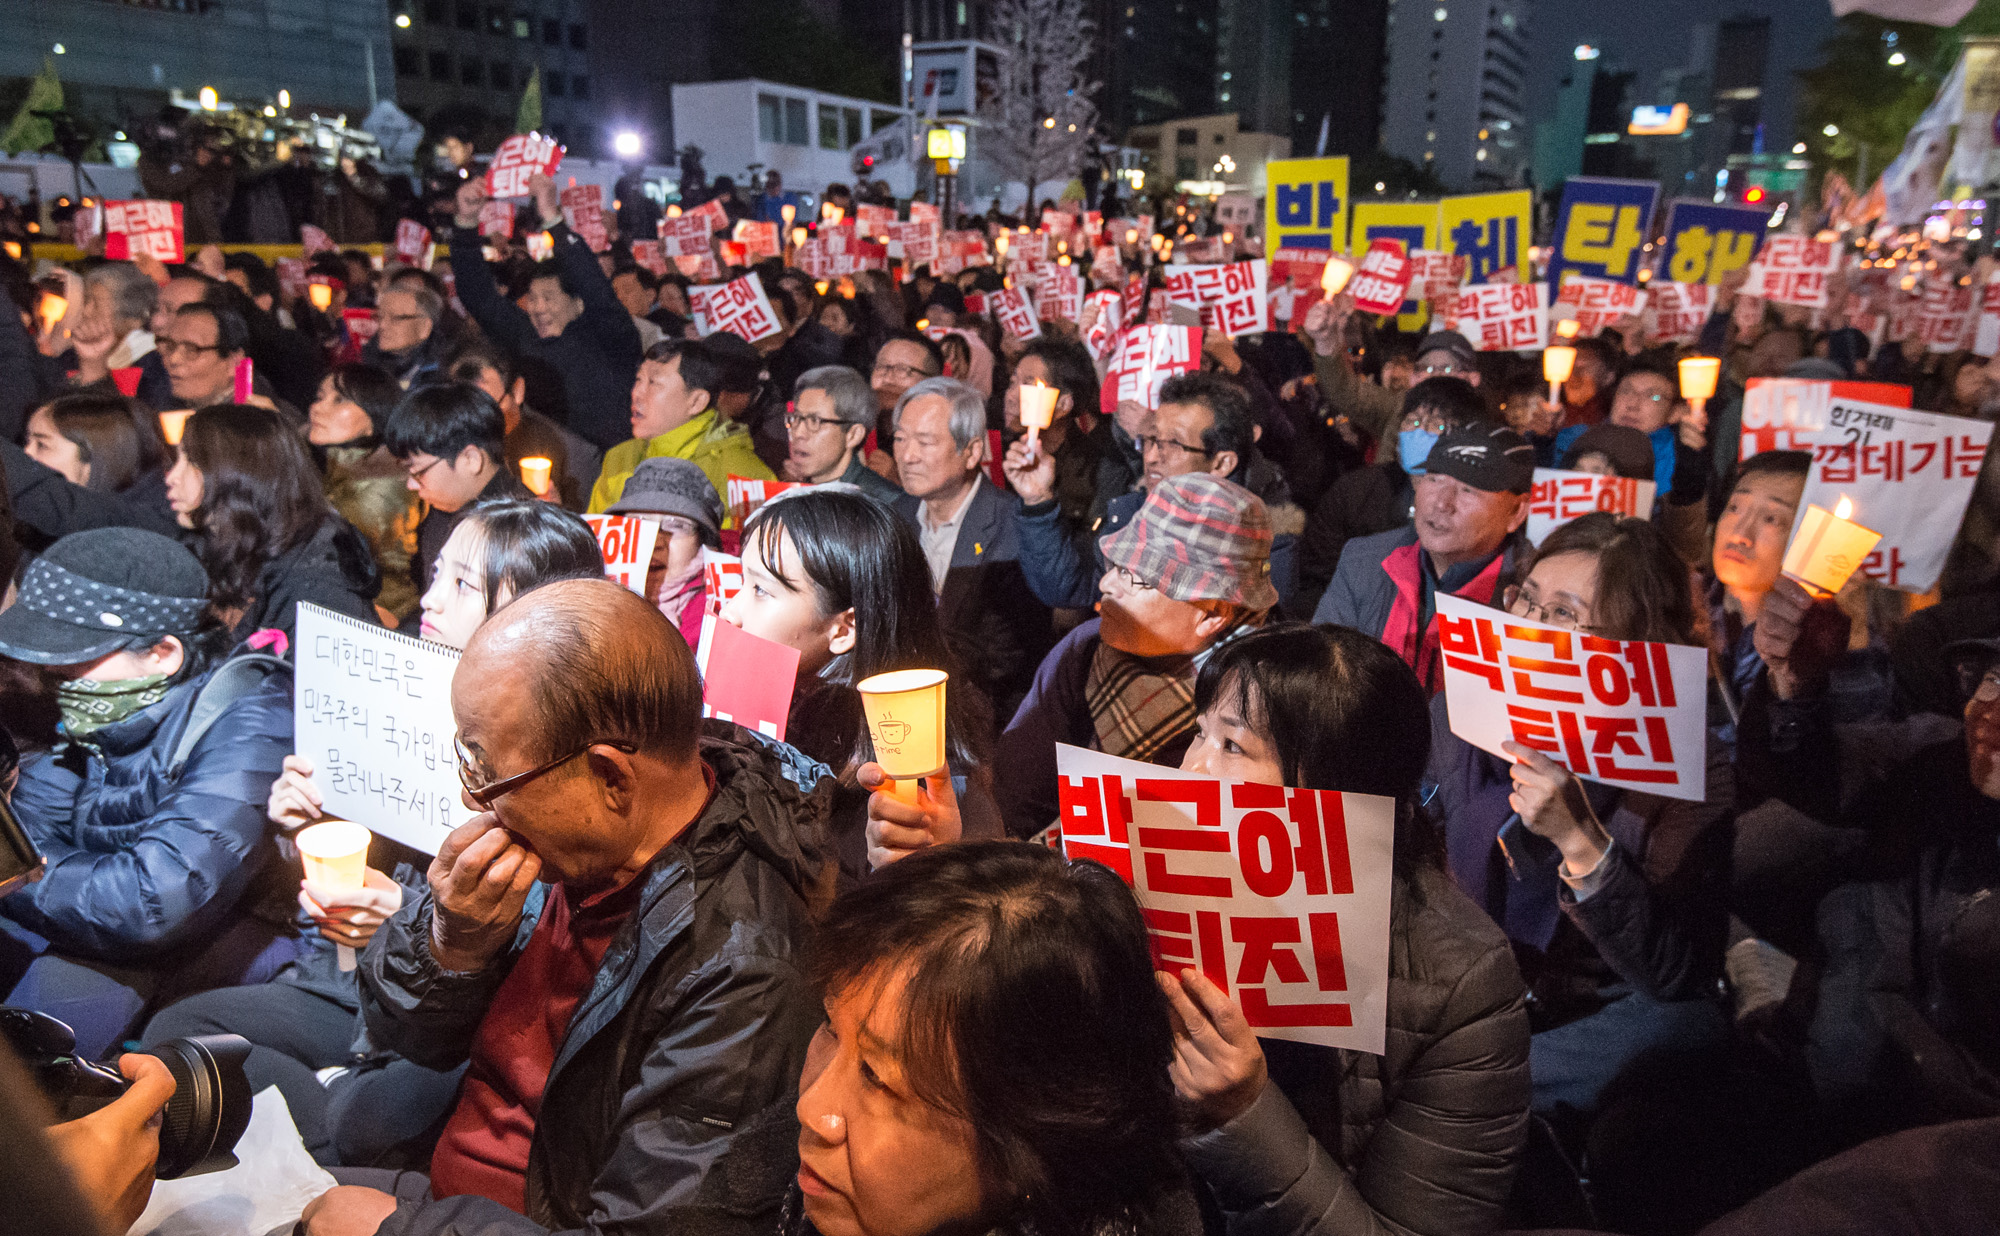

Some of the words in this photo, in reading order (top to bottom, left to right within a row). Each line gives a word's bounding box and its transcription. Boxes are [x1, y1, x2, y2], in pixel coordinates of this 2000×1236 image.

[690, 276, 757, 327] 박근혜
[1166, 261, 1256, 302] 박근혜
[1458, 284, 1539, 320] 박근혜
[1558, 283, 1637, 309] 박근혜
[1199, 295, 1258, 334] 퇴진
[1481, 314, 1539, 351] 퇴진
[1813, 435, 1988, 483] 껍데기는
[1530, 475, 1639, 520] 박근혜
[315, 635, 424, 699] 대한민국은
[1436, 611, 1678, 708] 박근혜
[383, 715, 458, 771] 국가입니
[1506, 703, 1680, 785] 퇴진
[326, 748, 457, 830] 물러나주세요
[1058, 774, 1355, 898] 박근혜
[1139, 907, 1354, 1028] 퇴진
